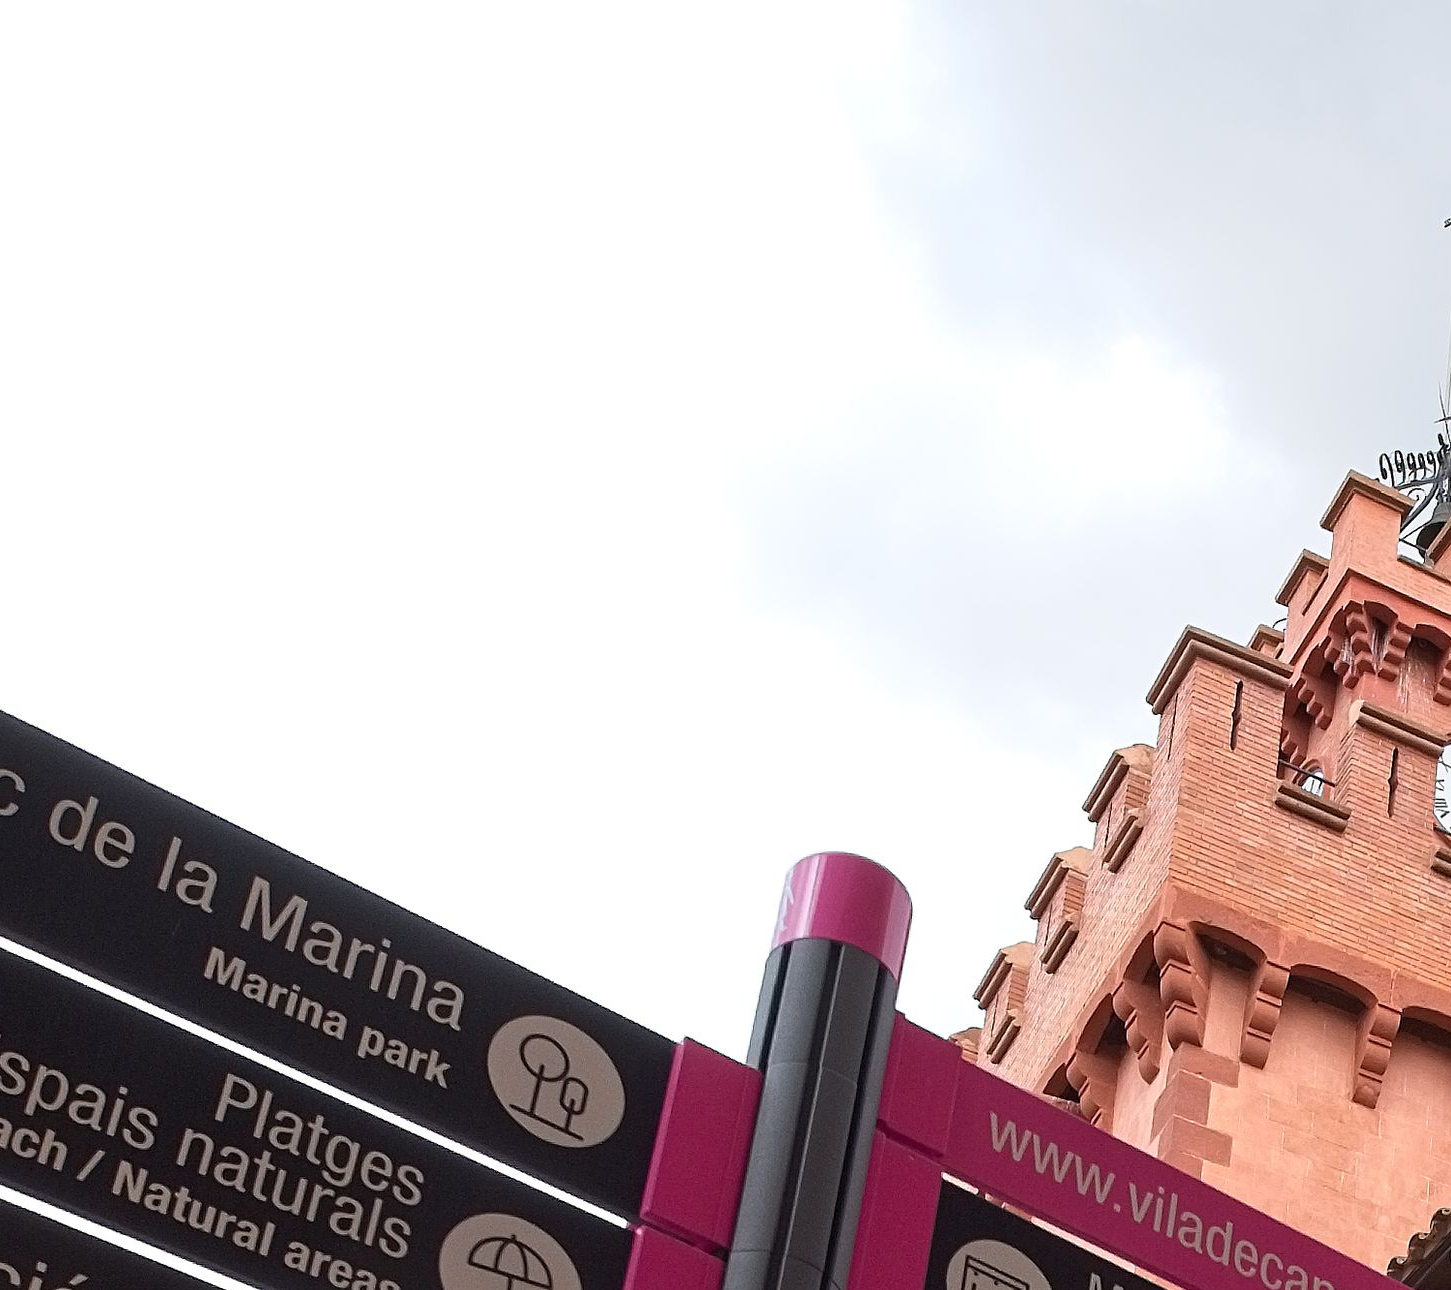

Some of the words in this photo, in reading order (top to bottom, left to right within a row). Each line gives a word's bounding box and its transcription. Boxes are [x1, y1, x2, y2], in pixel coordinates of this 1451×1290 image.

[50, 796, 135, 868] de
[158, 837, 217, 913] la
[241, 876, 463, 1031] Marina
[204, 947, 347, 1040] Marina
[358, 1026, 450, 1088] park
[77, 1150, 105, 1181] /
[112, 1160, 275, 1256] Natural
[177, 1129, 410, 1258] naturals
[215, 1074, 424, 1205] Platges
